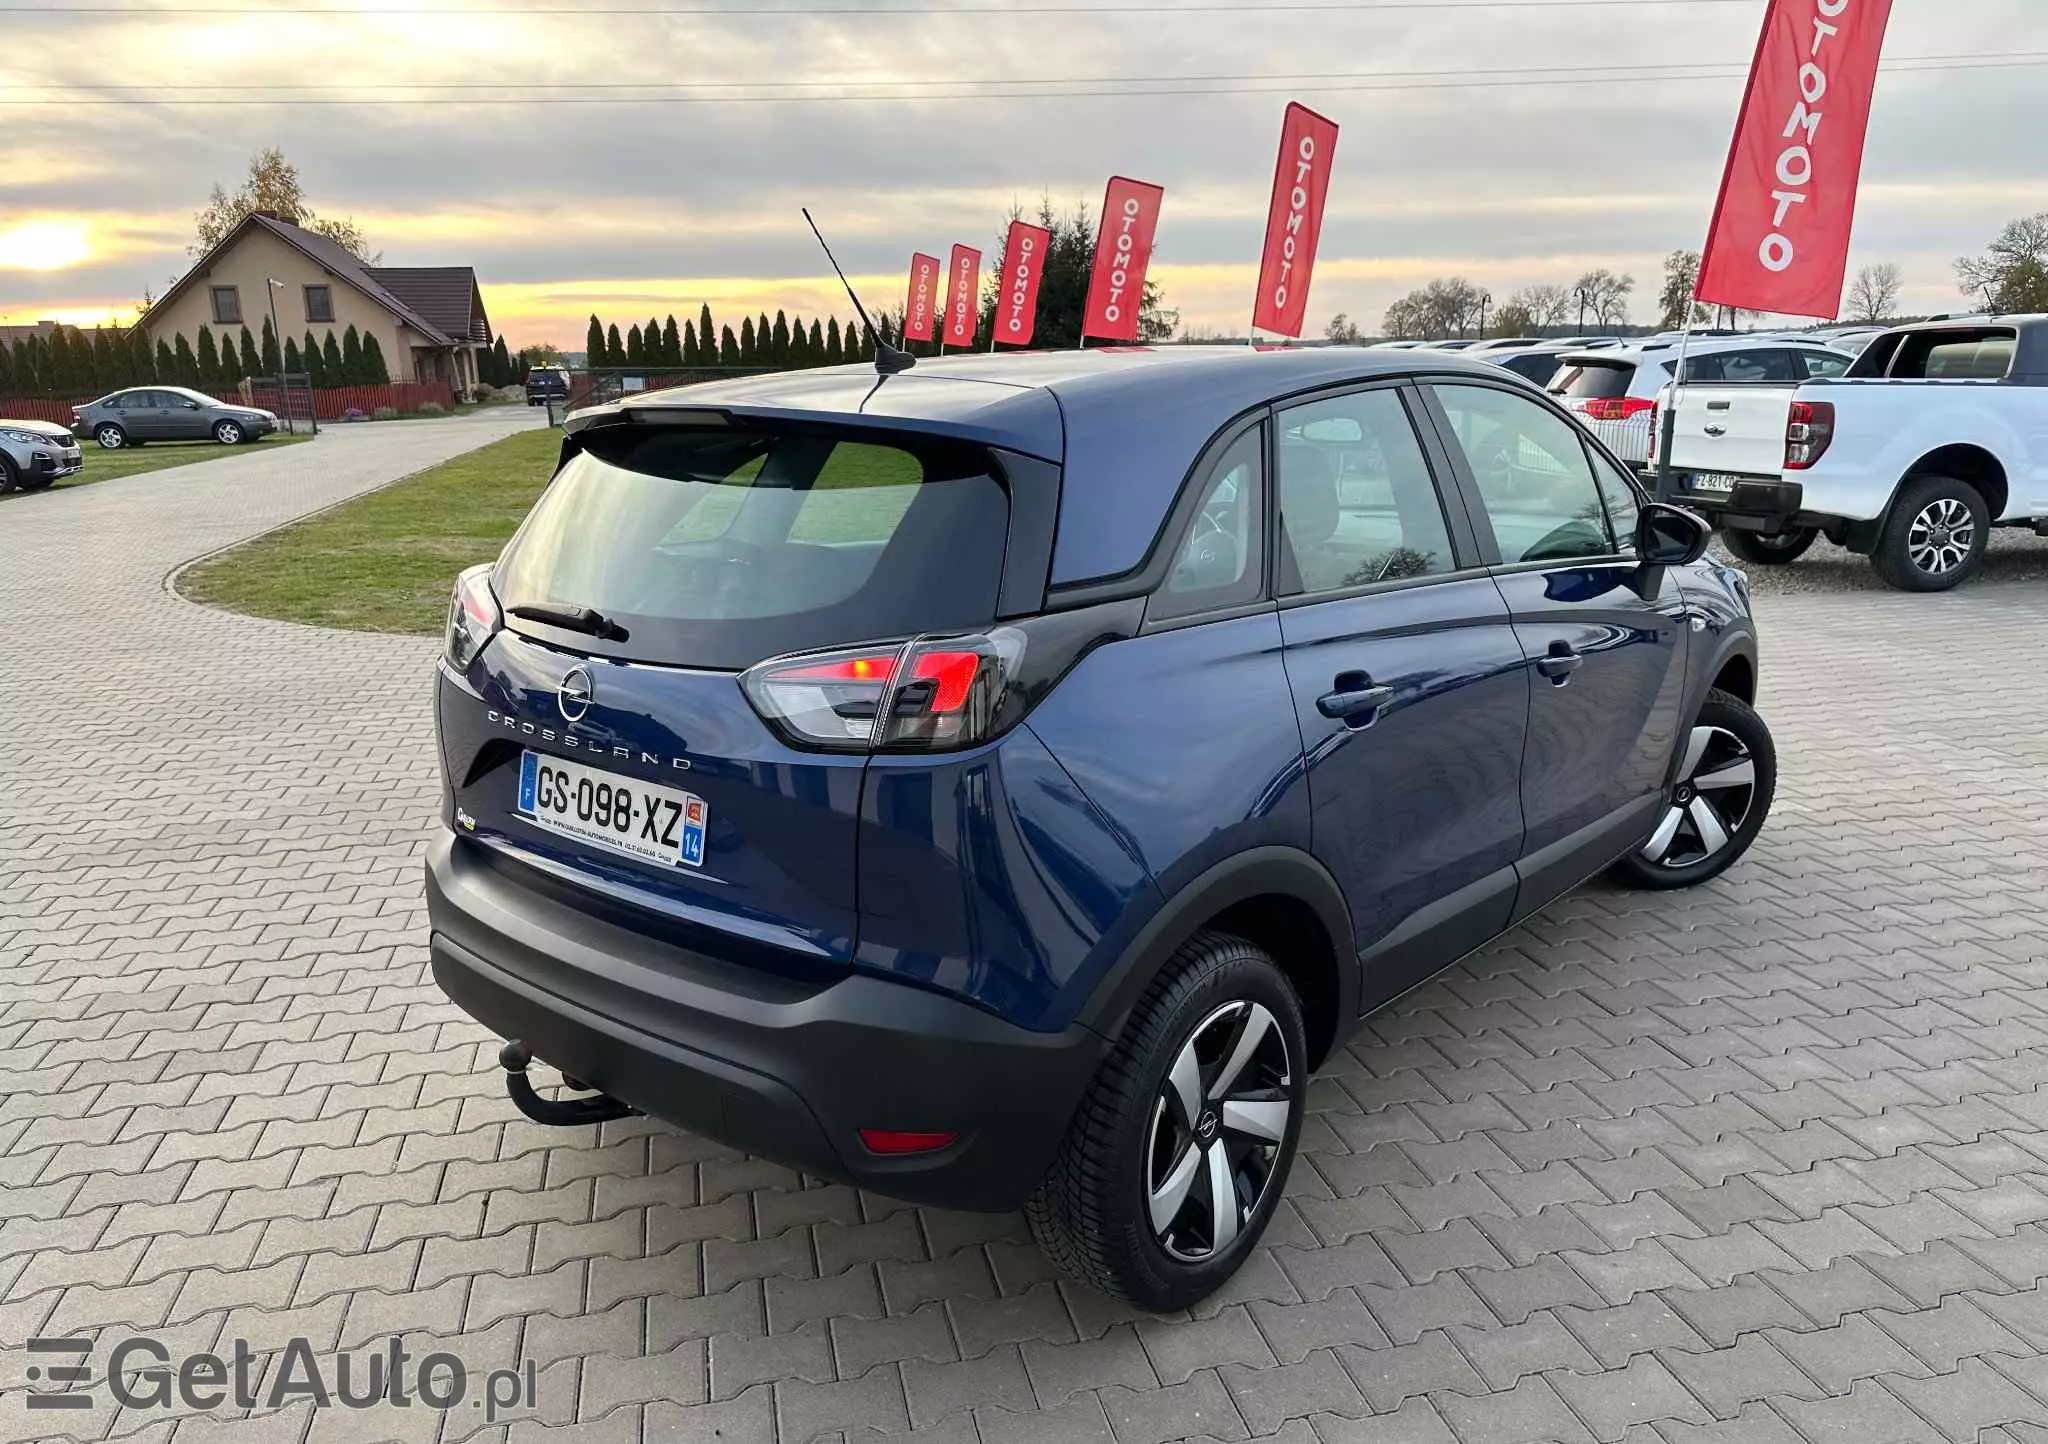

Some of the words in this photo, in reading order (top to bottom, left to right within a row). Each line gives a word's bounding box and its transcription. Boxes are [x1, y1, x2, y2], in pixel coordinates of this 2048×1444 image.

[1105, 198, 1139, 322] OTOMOTO
[1275, 136, 1315, 309] OTOMOTO
[914, 264, 930, 331] OTOMOTO
[954, 257, 971, 336] OTOMOTO
[1009, 237, 1034, 332] OTOMOTO
[487, 710, 692, 770] CROSSLAND
[525, 788, 532, 800] F
[537, 766, 683, 849] GS-098-XZ
[685, 832, 699, 858] 14
